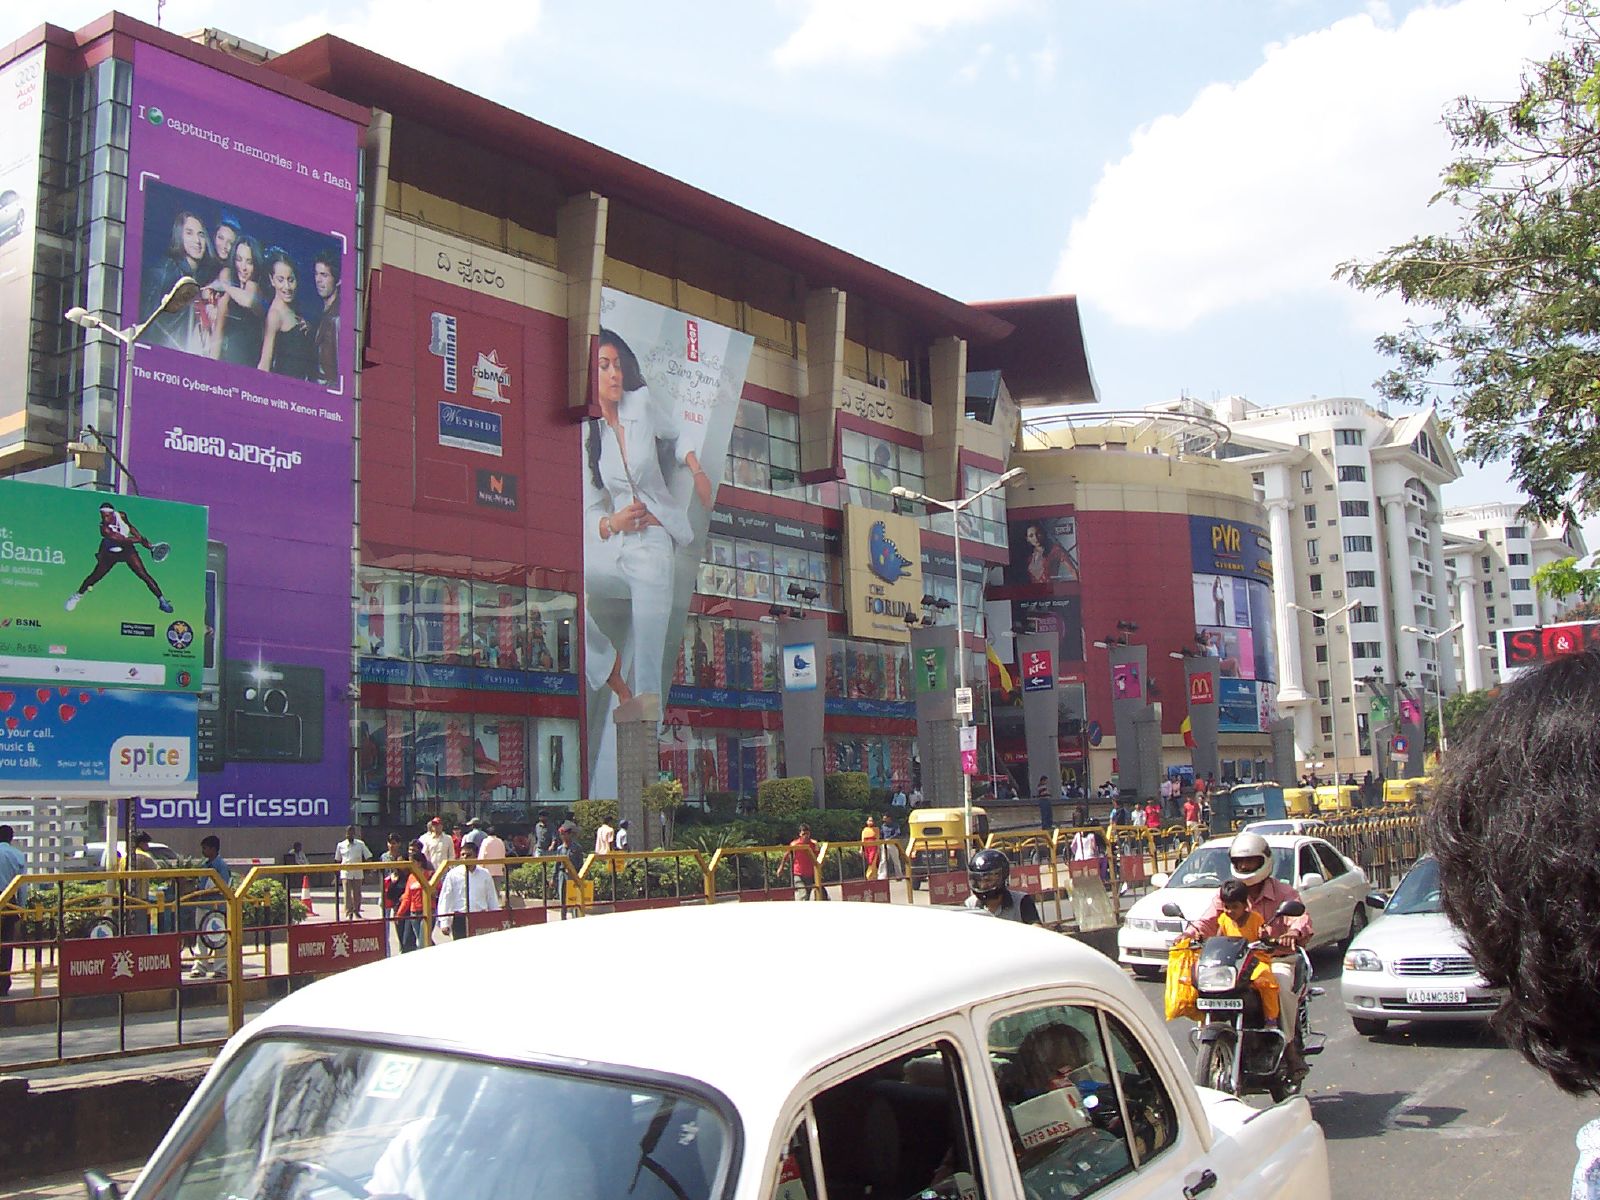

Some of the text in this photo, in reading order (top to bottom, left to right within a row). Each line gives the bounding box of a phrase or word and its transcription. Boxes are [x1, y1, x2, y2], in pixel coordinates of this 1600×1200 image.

[167, 117, 230, 150] capturing
[233, 140, 293, 171] memories
[297, 162, 308, 176] in
[312, 168, 321, 180] a
[323, 170, 352, 191] flash
[445, 317, 456, 391] landmark
[133, 366, 152, 380] The
[153, 368, 180, 386] K790i
[241, 390, 269, 406] Phone
[270, 397, 289, 411] with
[290, 401, 318, 417] Xenon
[319, 408, 344, 423] Flash.
[442, 406, 498, 433] WESTSIDE
[684, 410, 704, 425] RULE!
[164, 426, 226, 458] ಸೋನಿ
[1211, 524, 1241, 552] PVR
[1, 541, 66, 565] Sania
[865, 595, 912, 618] FORUM
[16, 618, 42, 628] BSNL
[1028, 661, 1047, 676] KFC
[8, 728, 31, 739] your
[33, 727, 54, 738] call.
[27, 741, 36, 752] &
[120, 742, 180, 773] spice
[20, 757, 42, 768] talk.
[140, 793, 329, 825] Sony Ericsson
[298, 937, 380, 957] HUNGRY BUDDHA
[70, 953, 171, 976] HUNGRY BUDDHA
